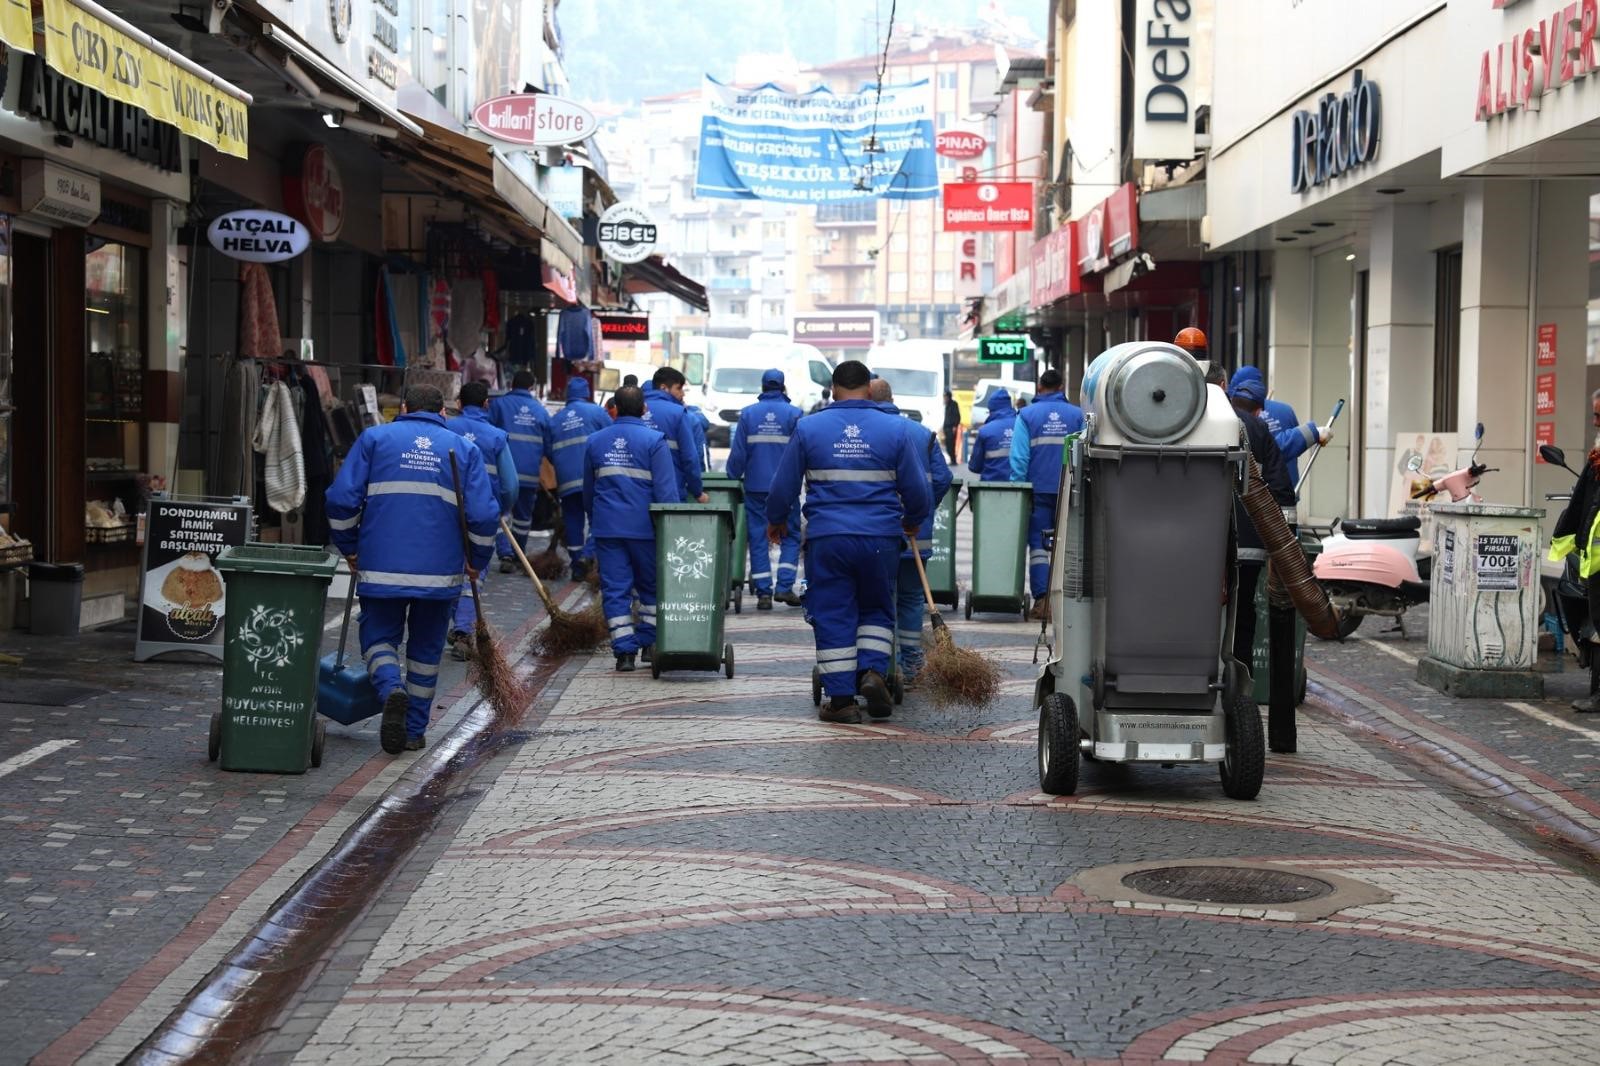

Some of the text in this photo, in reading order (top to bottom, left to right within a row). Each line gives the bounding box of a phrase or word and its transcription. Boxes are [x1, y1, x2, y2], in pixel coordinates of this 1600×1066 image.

[538, 107, 583, 131] store
[936, 136, 982, 149] PINAR
[734, 160, 835, 182] TEŞEKKÜR
[217, 218, 295, 236] ATÇALI
[223, 238, 294, 254] HELVA
[986, 342, 1023, 355] TOST
[160, 507, 238, 521] DONDURMALI
[181, 518, 214, 530] İRMİK
[169, 530, 224, 543] SATIŞIMIZ
[1490, 536, 1510, 545] TATİL
